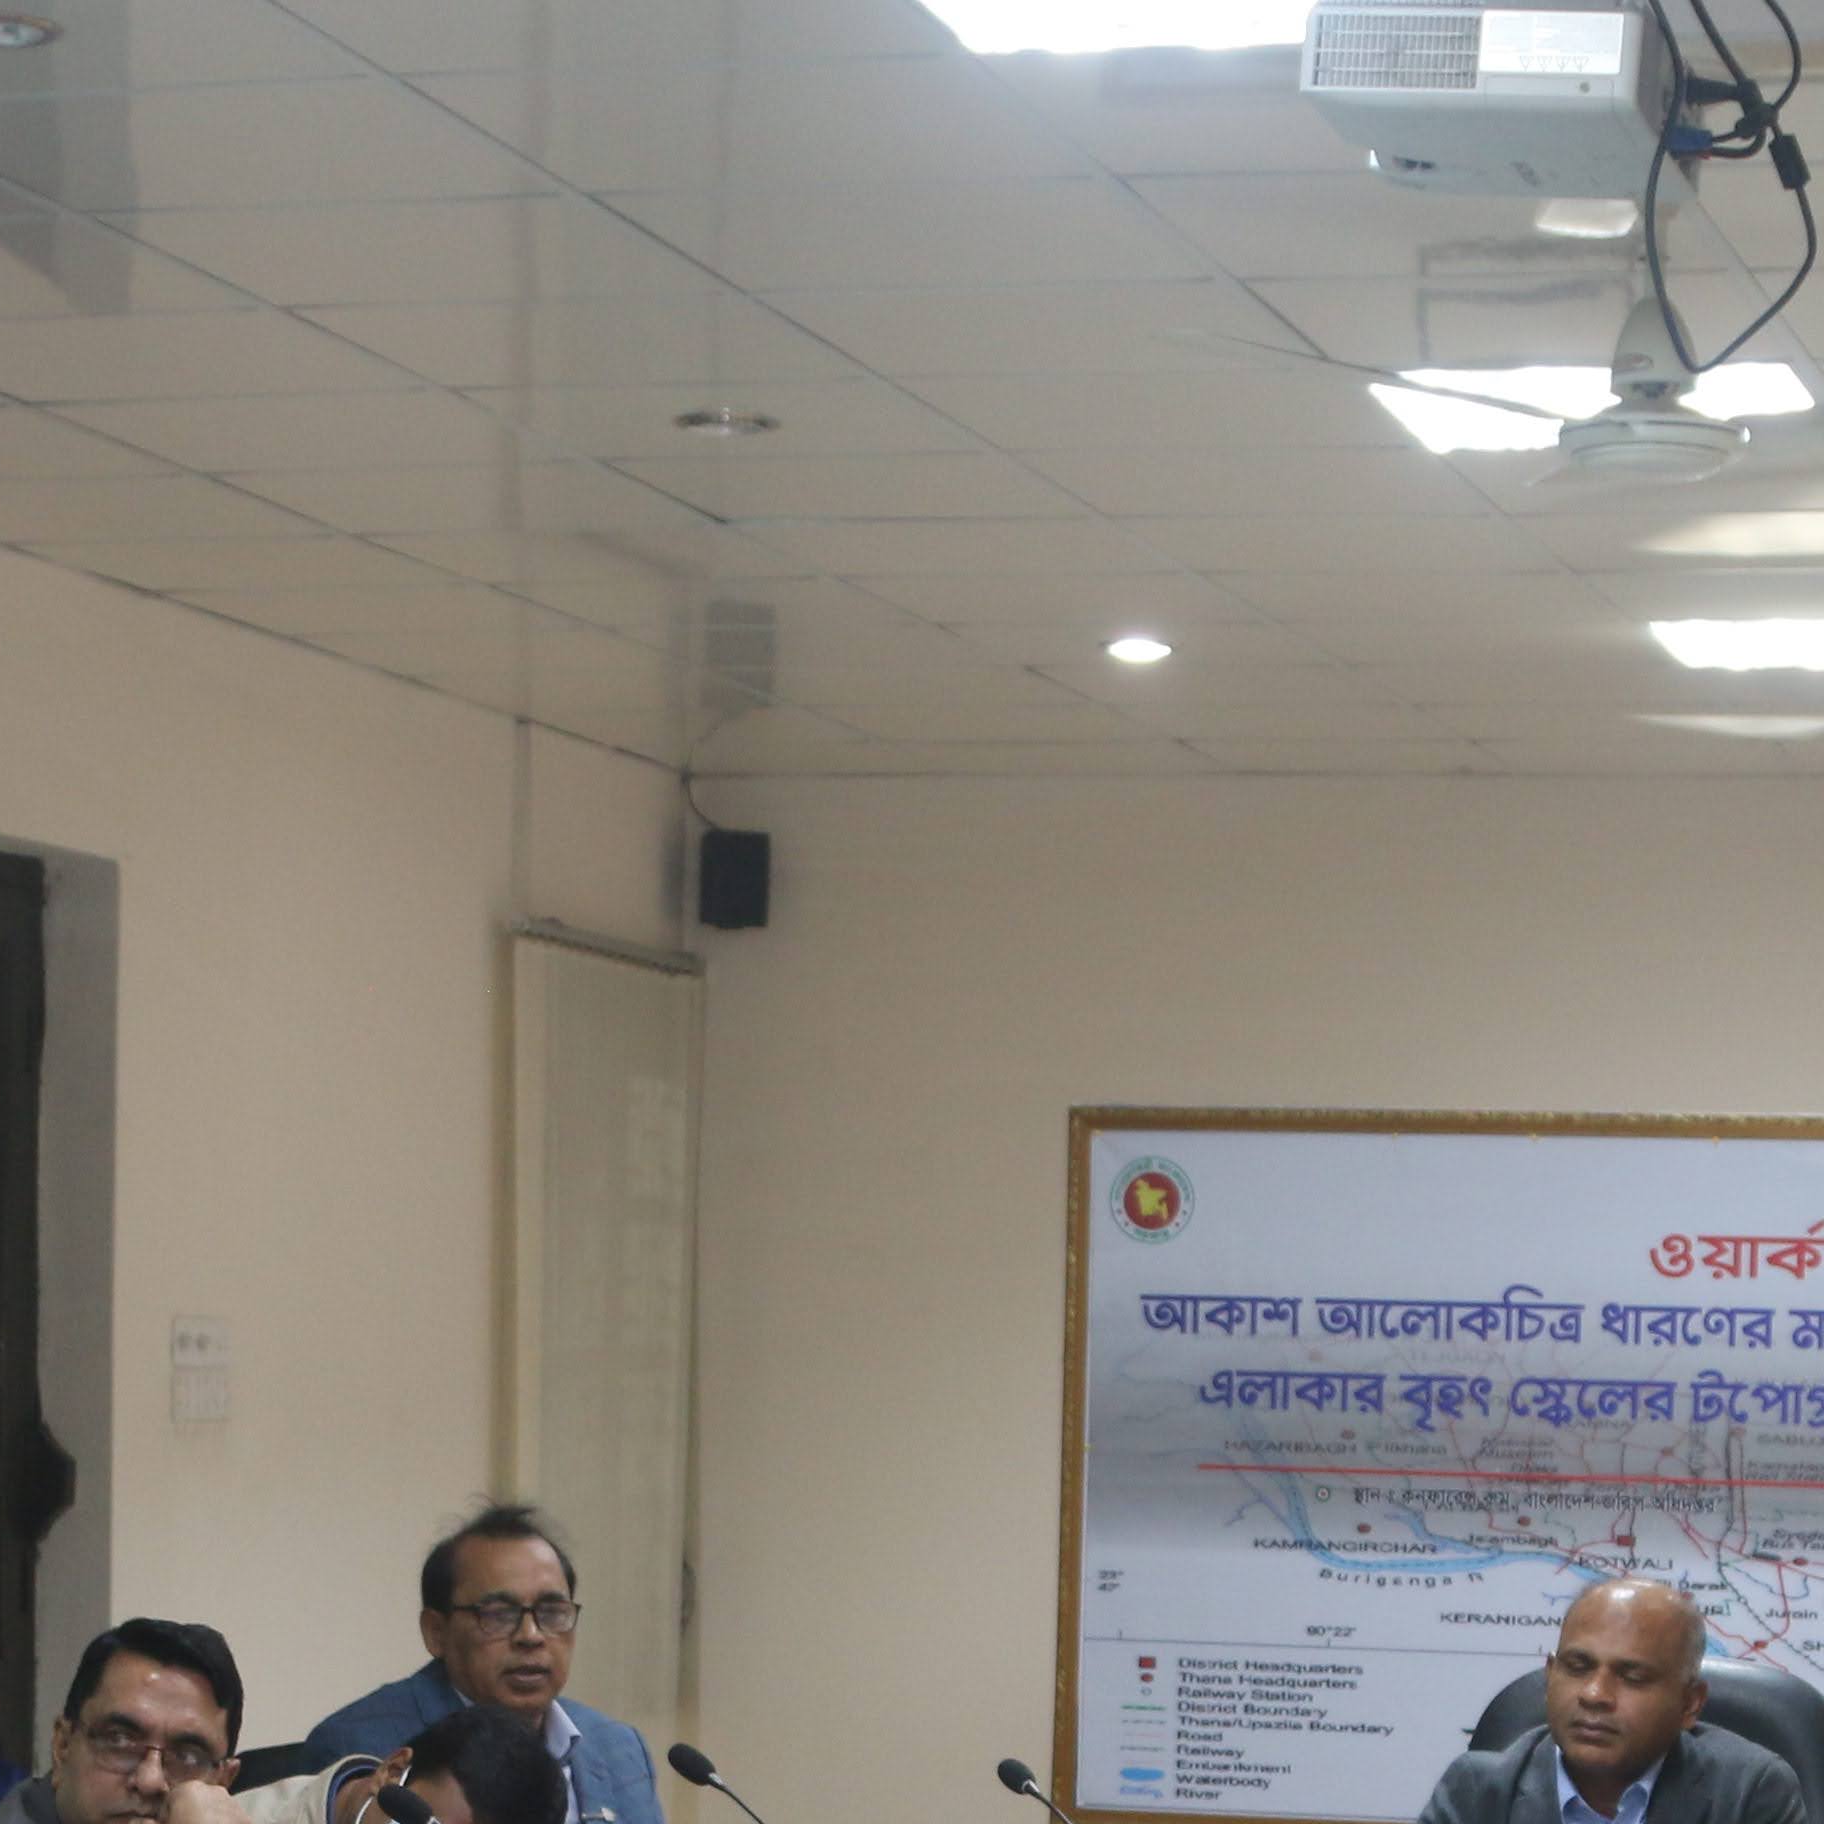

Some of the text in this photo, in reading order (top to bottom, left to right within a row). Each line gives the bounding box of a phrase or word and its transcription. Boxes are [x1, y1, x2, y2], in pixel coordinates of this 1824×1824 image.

[1140, 1294, 1301, 1338] আকাশ
[1316, 1284, 1586, 1345] আলোকচিত্র
[1601, 1302, 1773, 1350] ধারণের
[1199, 1369, 1387, 1414] এলাকার
[1399, 1374, 1493, 1433] বৃহৎ
[1510, 1377, 1677, 1427] স্কেলের
[1440, 1610, 1566, 1628] KERANIGAN
[1177, 1656, 1364, 1676] District Headquarters
[1179, 1671, 1359, 1690] Thana Headquarters
[1176, 1686, 1314, 1703] Railway Station
[1176, 1701, 1329, 1719] District Boundary
[1176, 1730, 1224, 1743] Road
[1308, 1720, 1395, 1737] Boundary
[1175, 1745, 1246, 1760] Railway
[1176, 1774, 1272, 1790] Waterbody
[1175, 1788, 1223, 1801] River
